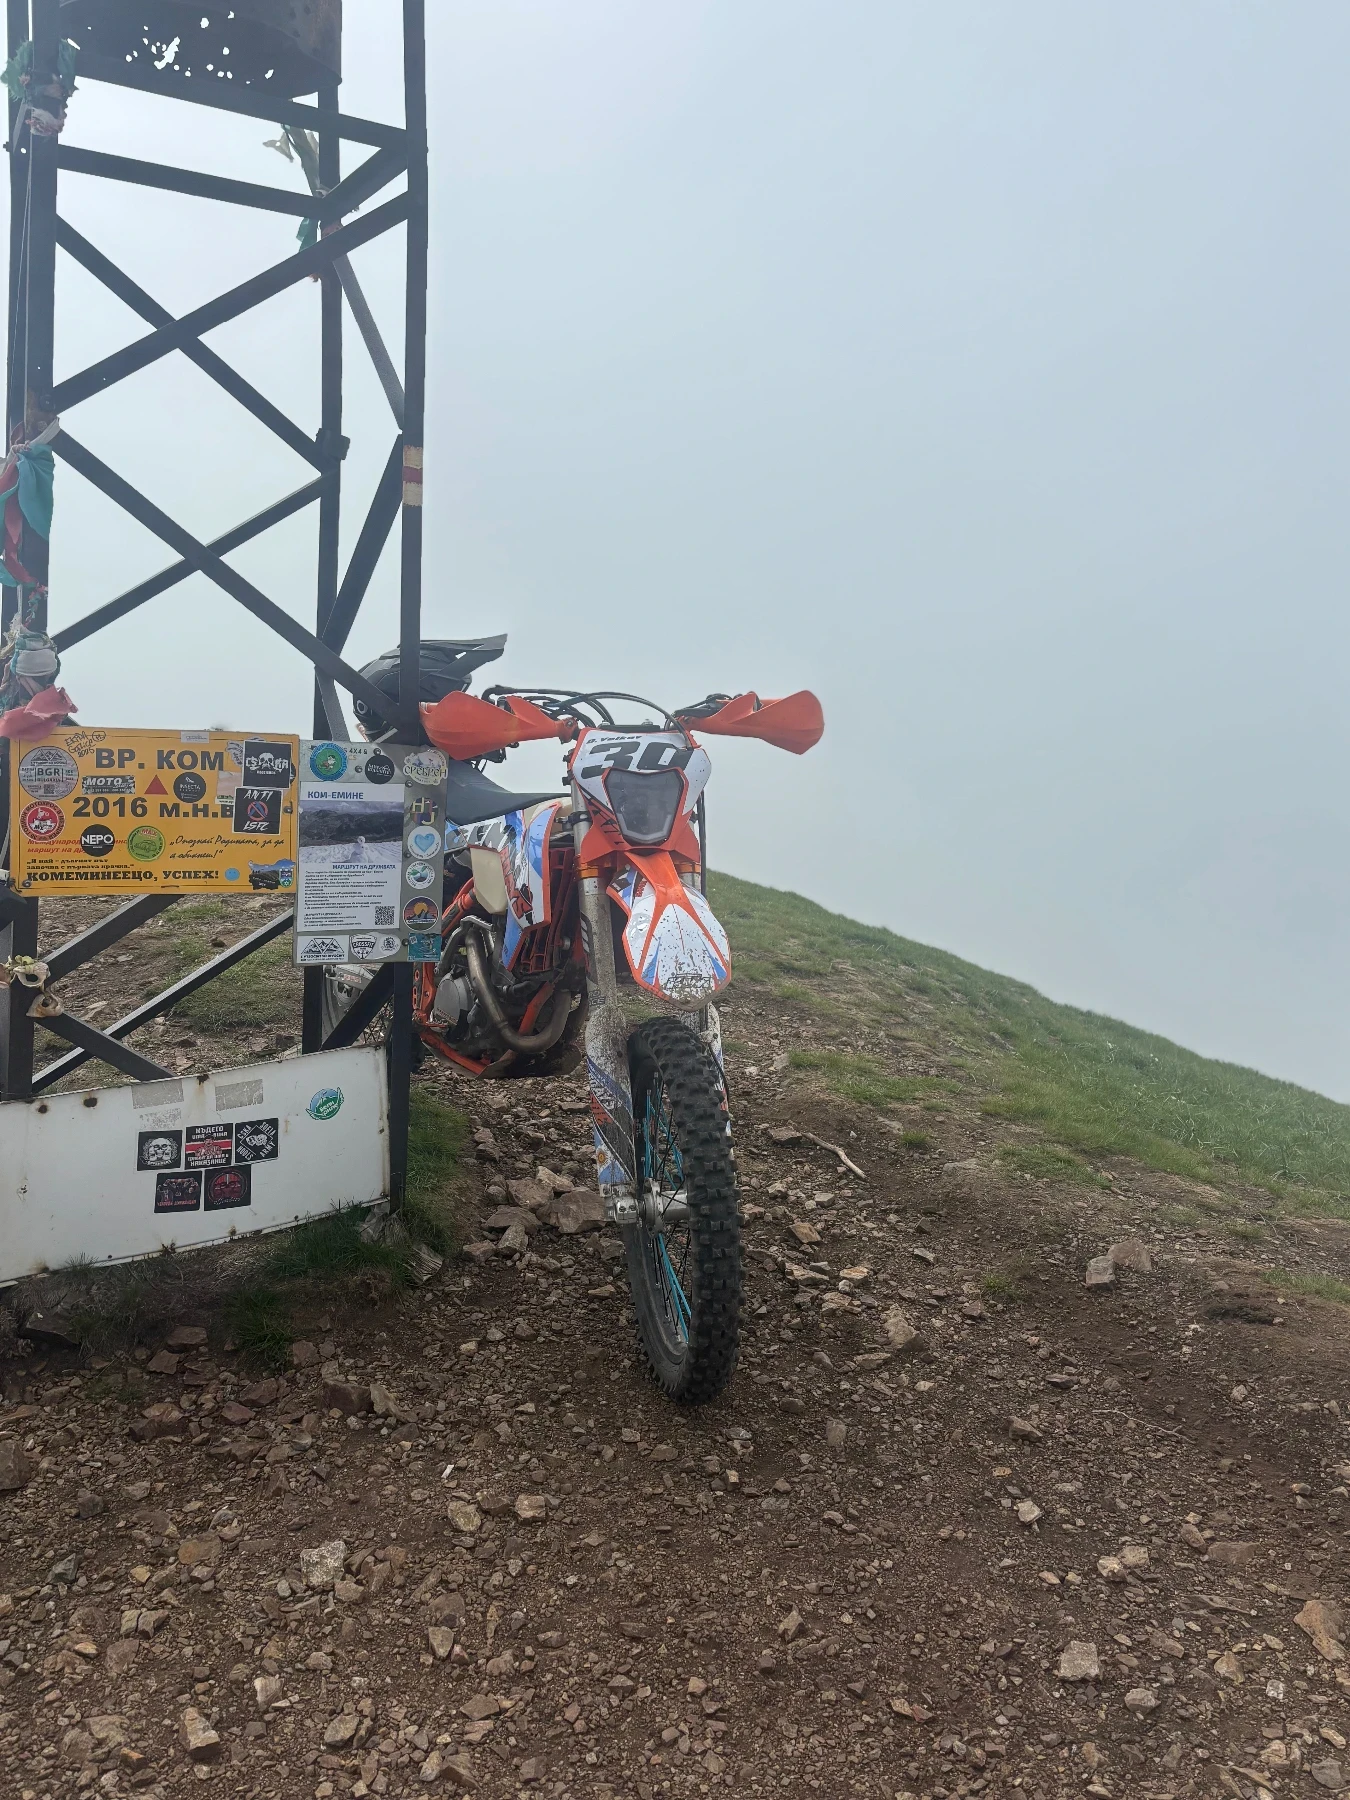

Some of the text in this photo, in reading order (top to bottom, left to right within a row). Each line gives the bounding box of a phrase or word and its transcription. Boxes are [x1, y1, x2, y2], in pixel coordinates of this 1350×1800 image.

[95, 748, 145, 769] ВР.
[157, 749, 224, 771] КОМ
[37, 768, 60, 776] BGR
[307, 791, 364, 799] КОМ-ЕМИНЕ
[73, 797, 148, 818] 2016
[81, 834, 113, 845] NEPO
[26, 870, 219, 882] КОМЕМИНЕЕЦО, УСПЕХ!
[237, 1124, 252, 1139] CSKA
[259, 1121, 276, 1136] SOFIA
[259, 1141, 276, 1158] ARMY
